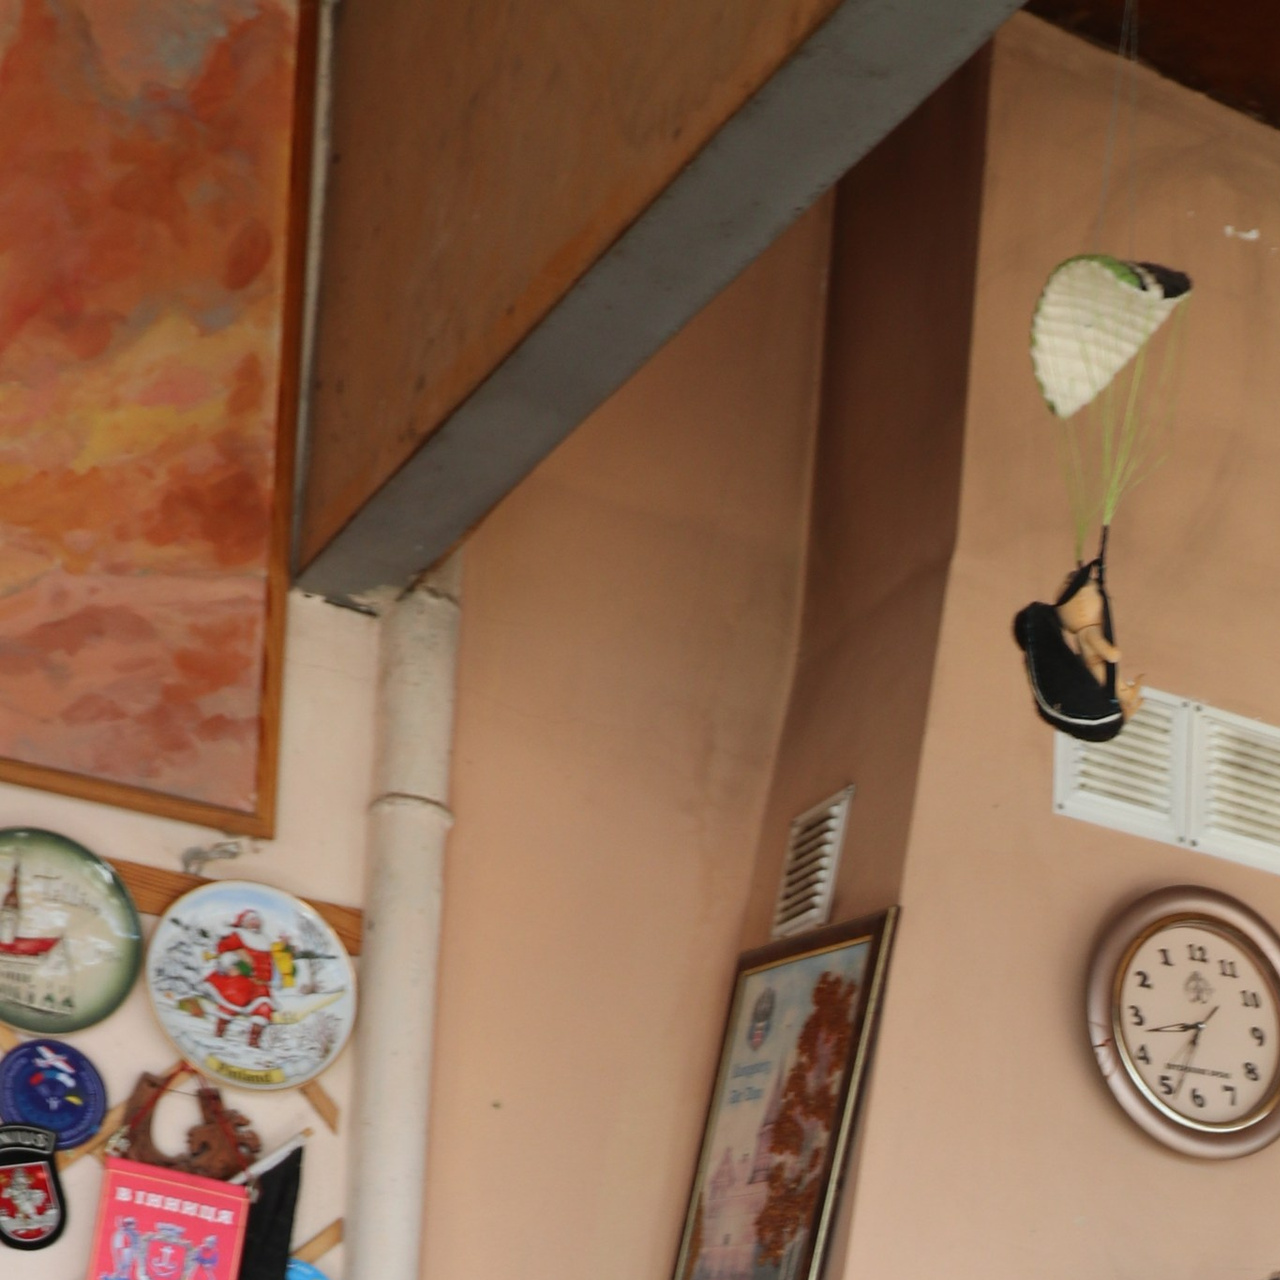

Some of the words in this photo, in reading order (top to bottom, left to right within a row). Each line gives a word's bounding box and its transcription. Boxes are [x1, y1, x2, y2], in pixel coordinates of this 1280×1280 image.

[1158, 948, 1175, 966] 1
[1187, 943, 1208, 963] 12
[1218, 959, 1239, 979] 11
[1134, 970, 1153, 989] 2
[1240, 990, 1261, 1009] 10
[1128, 1005, 1145, 1026] 3
[1250, 1026, 1265, 1047] 9
[1134, 1044, 1151, 1065] 4
[1243, 1062, 1259, 1081] 8
[1158, 1075, 1174, 1095] 5
[1222, 1084, 1237, 1106] 7
[1191, 1088, 1205, 1108] 6
